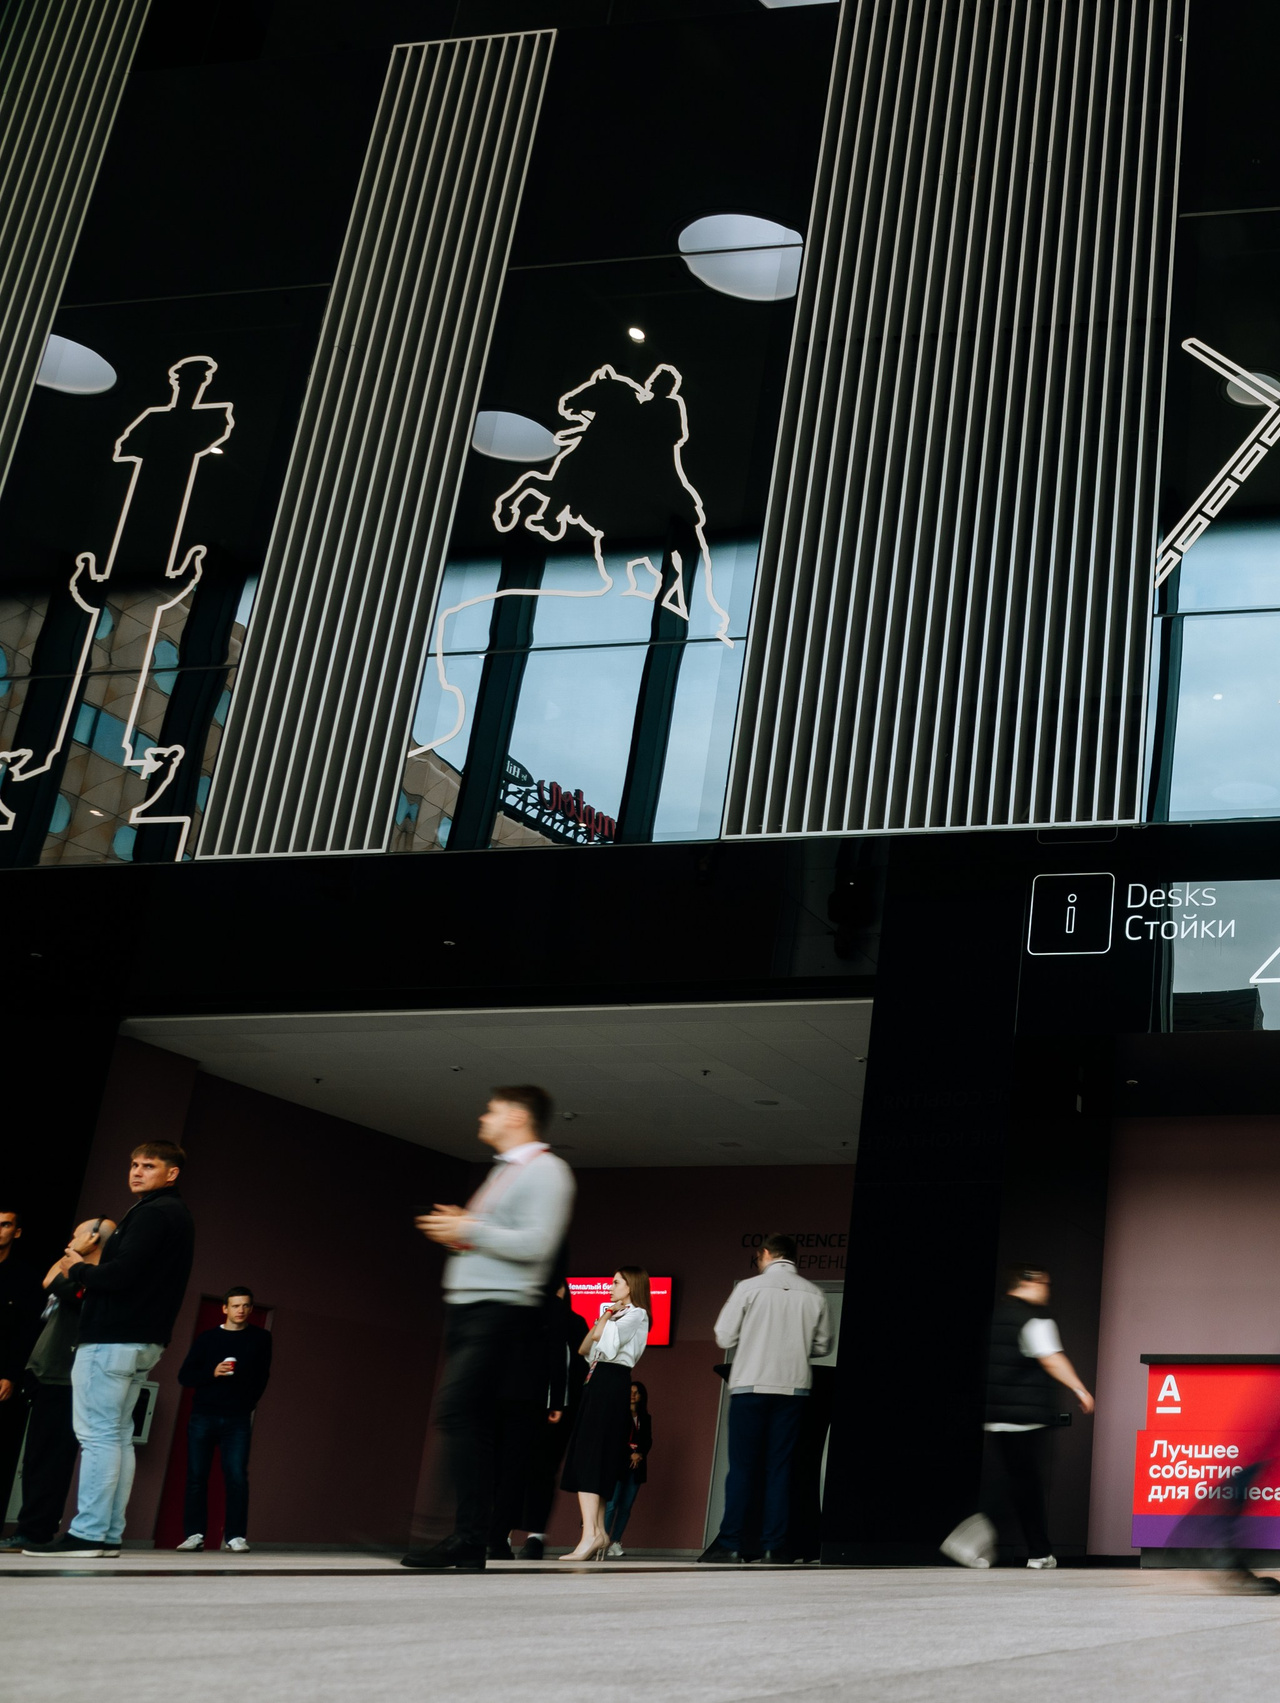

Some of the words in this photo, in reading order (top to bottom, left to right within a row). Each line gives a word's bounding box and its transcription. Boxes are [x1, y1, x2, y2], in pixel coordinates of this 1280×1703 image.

[1126, 883, 1217, 909] Desks
[1124, 913, 1236, 941] Стойки
[741, 1233, 847, 1248] CORENCE
[1150, 1440, 1239, 1462] Лучшее
[1148, 1485, 1189, 1502] для
